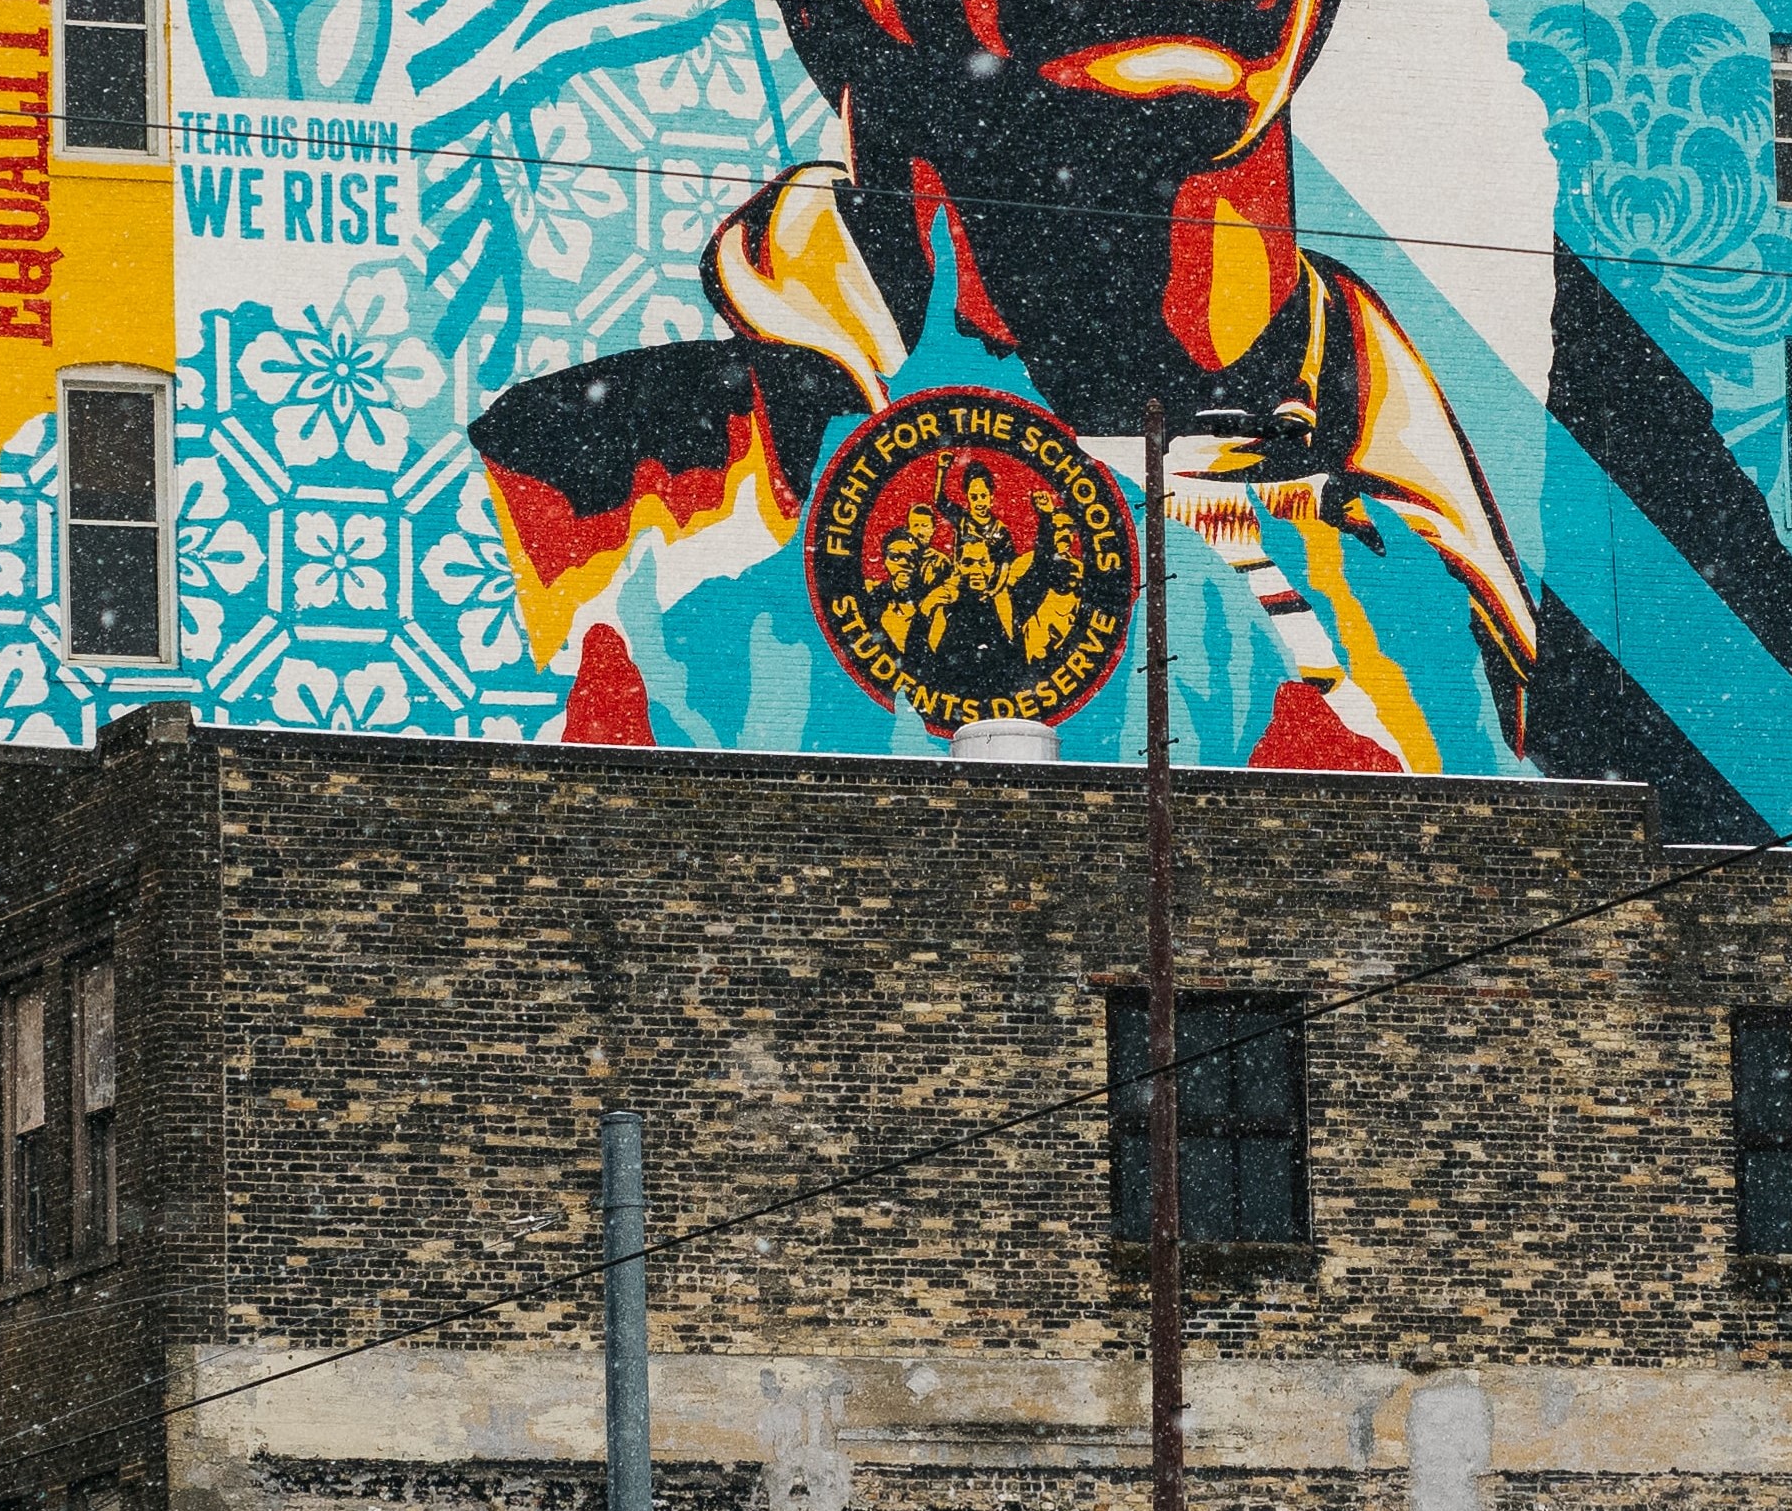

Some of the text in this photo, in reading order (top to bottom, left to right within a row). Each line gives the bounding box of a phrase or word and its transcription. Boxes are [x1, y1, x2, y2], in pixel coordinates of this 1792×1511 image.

[178, 110, 399, 166] TEAR US DOWN
[179, 164, 400, 246] WE RISE
[826, 407, 1122, 572] FIGHT FOR THE SCHOOLS
[832, 594, 1116, 724] STUDENTS DESERVE
